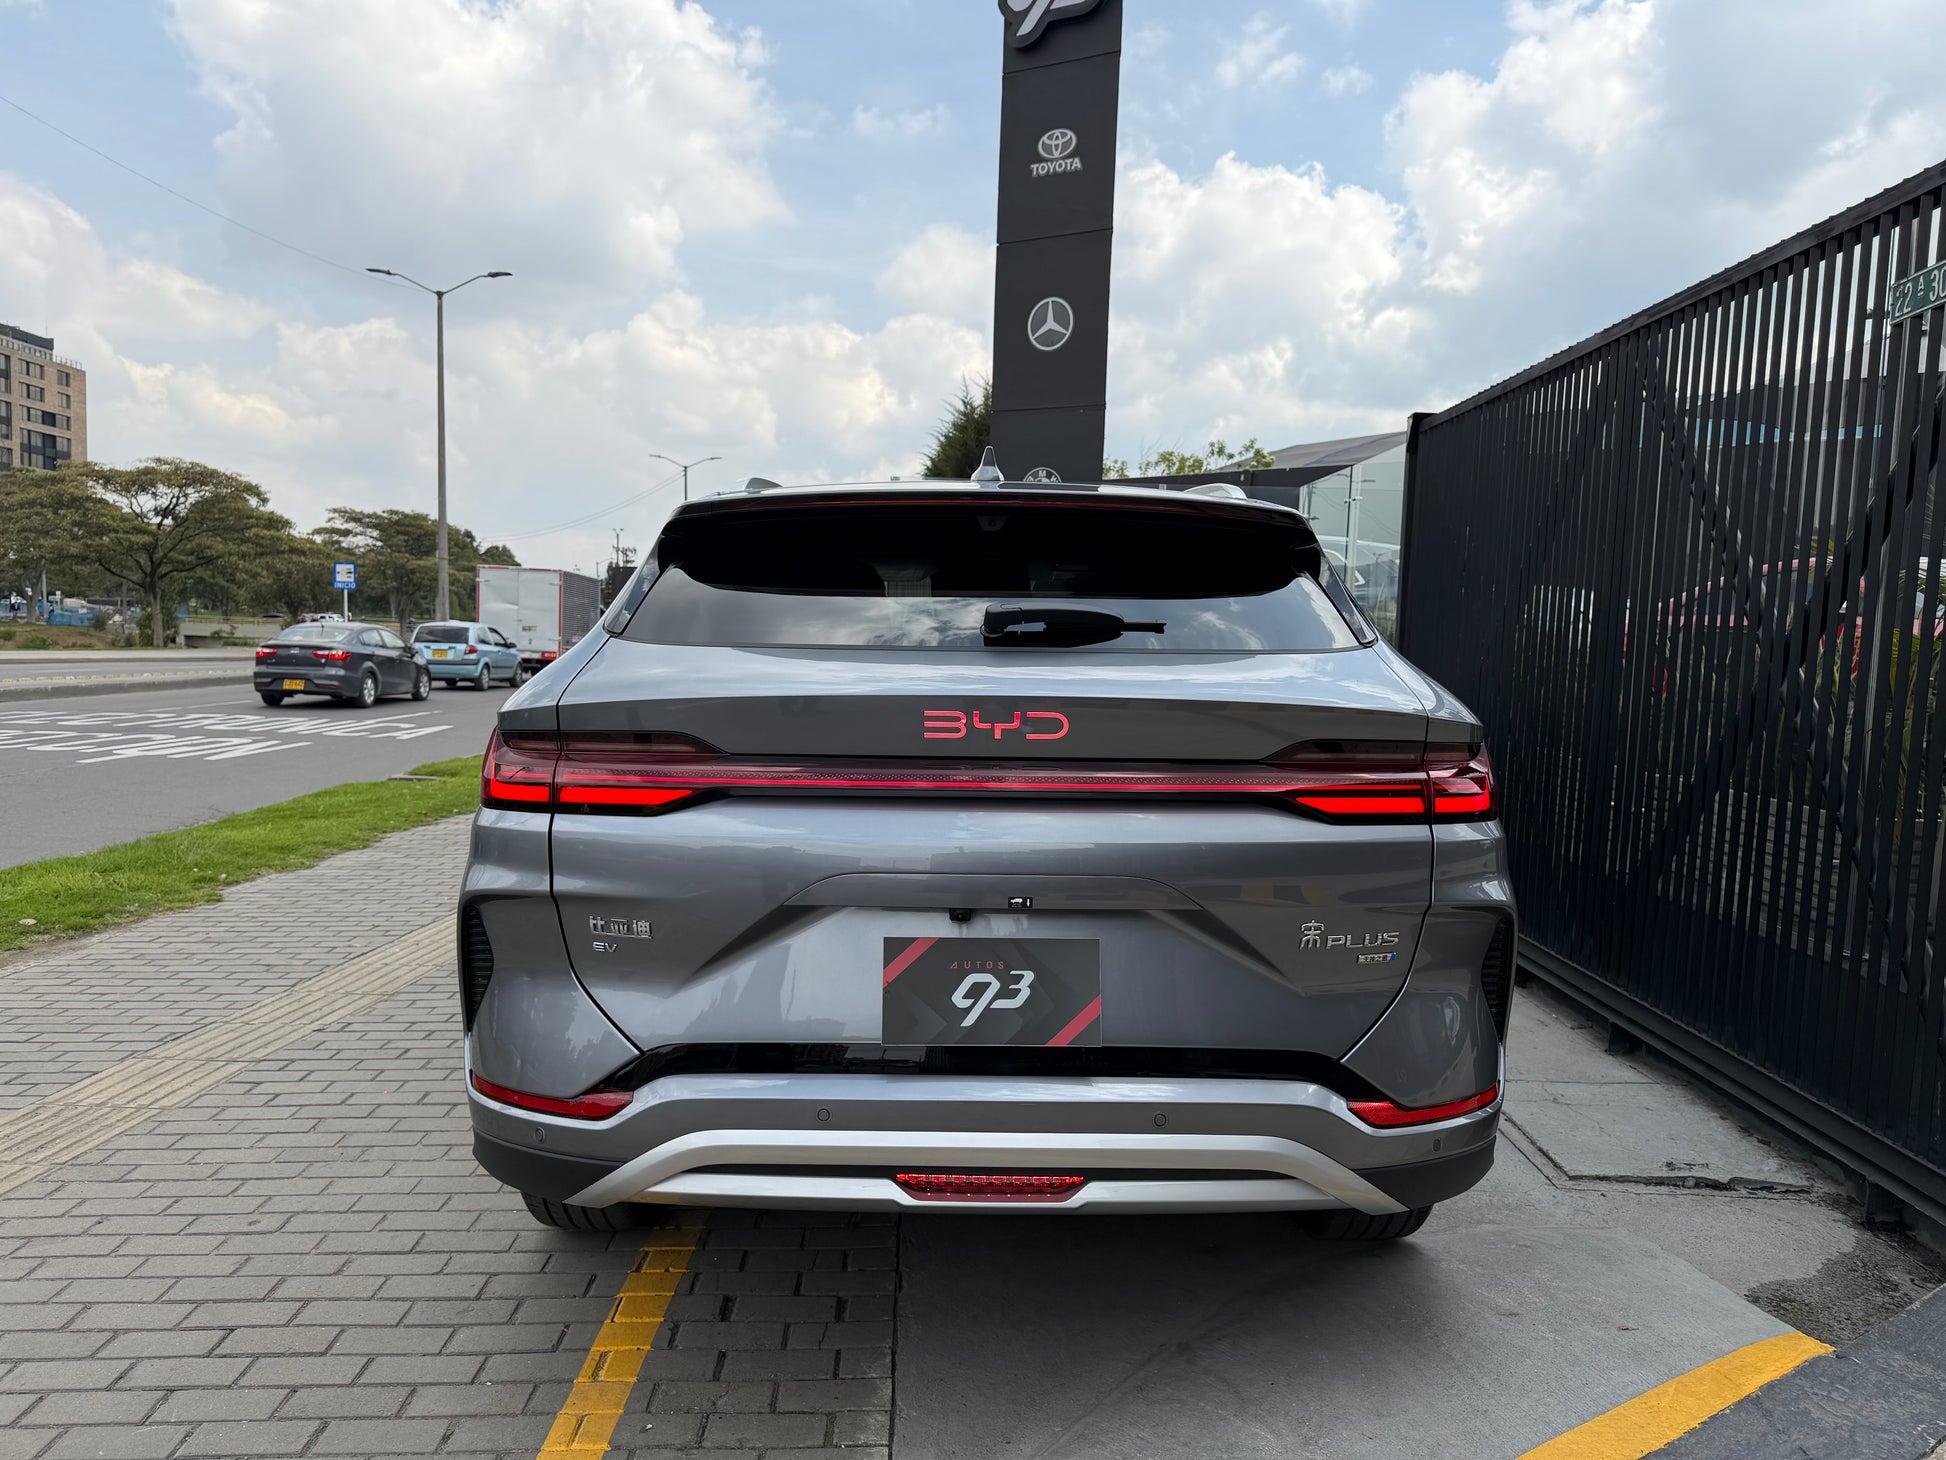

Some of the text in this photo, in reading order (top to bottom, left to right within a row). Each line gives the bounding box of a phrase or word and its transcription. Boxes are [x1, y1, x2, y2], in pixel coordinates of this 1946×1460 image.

[1030, 157, 1083, 178] TOYOTA
[1894, 282, 1913, 317] 22
[334, 581, 356, 590] INICIO
[923, 710, 1070, 740] BYD
[592, 941, 617, 952] EV
[950, 961, 1005, 969] AUTOS
[951, 970, 1035, 1027] 93
